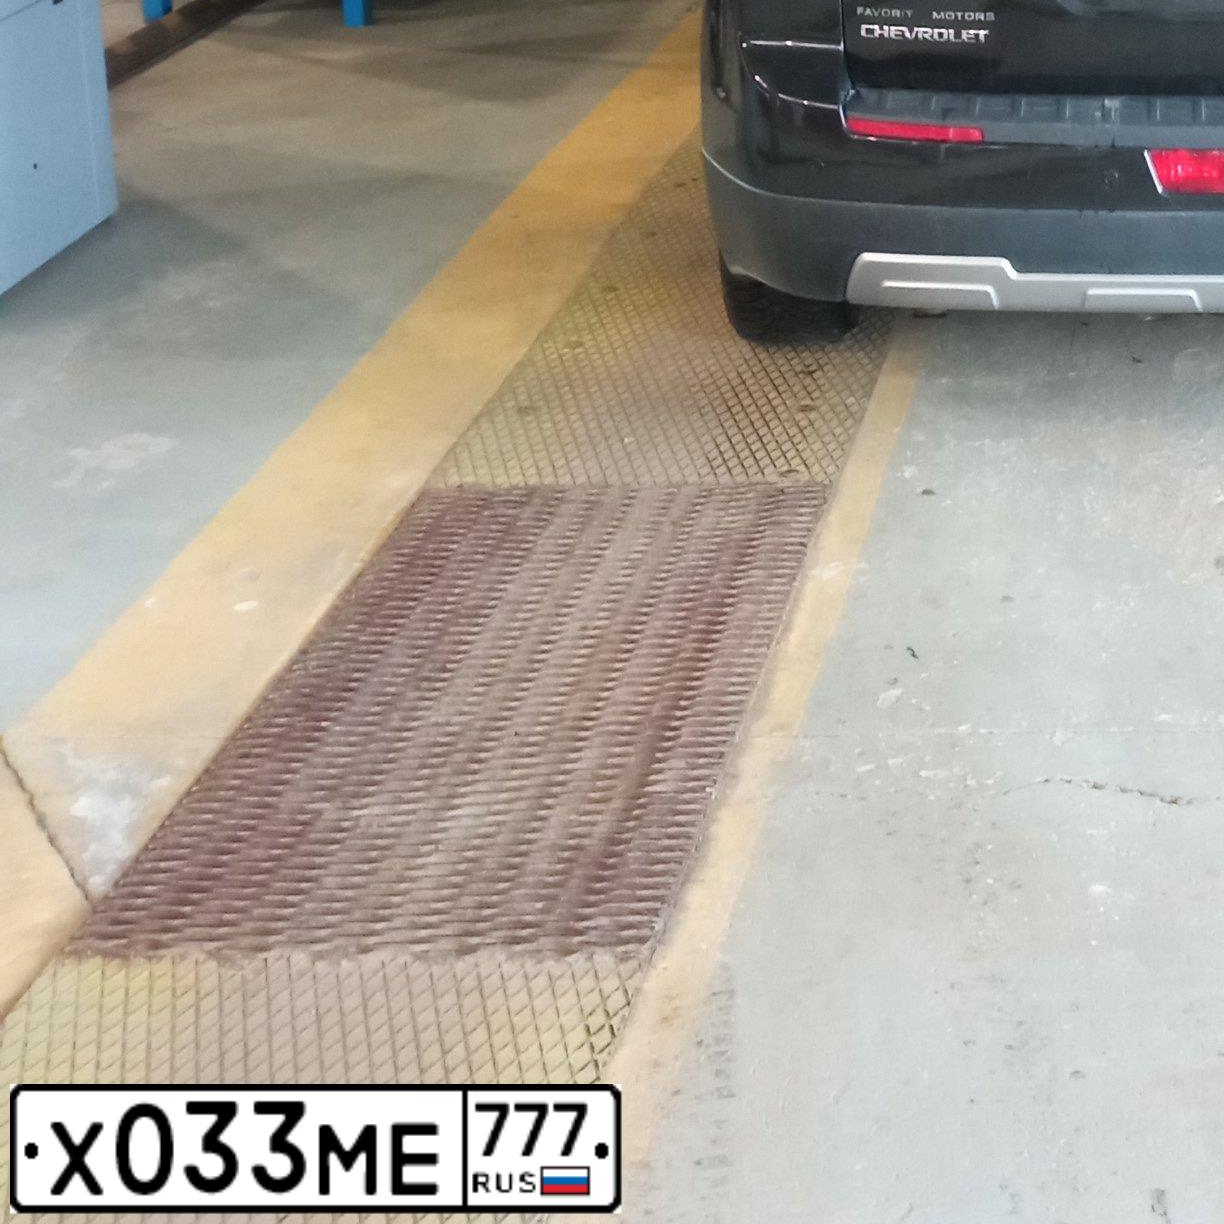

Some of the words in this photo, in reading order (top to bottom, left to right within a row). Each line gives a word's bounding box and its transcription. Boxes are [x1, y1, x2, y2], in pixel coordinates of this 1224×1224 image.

[856, 6, 914, 19] FAVORIT
[932, 11, 996, 22] MOTORS
[860, 23, 990, 44] CHEVROLET
